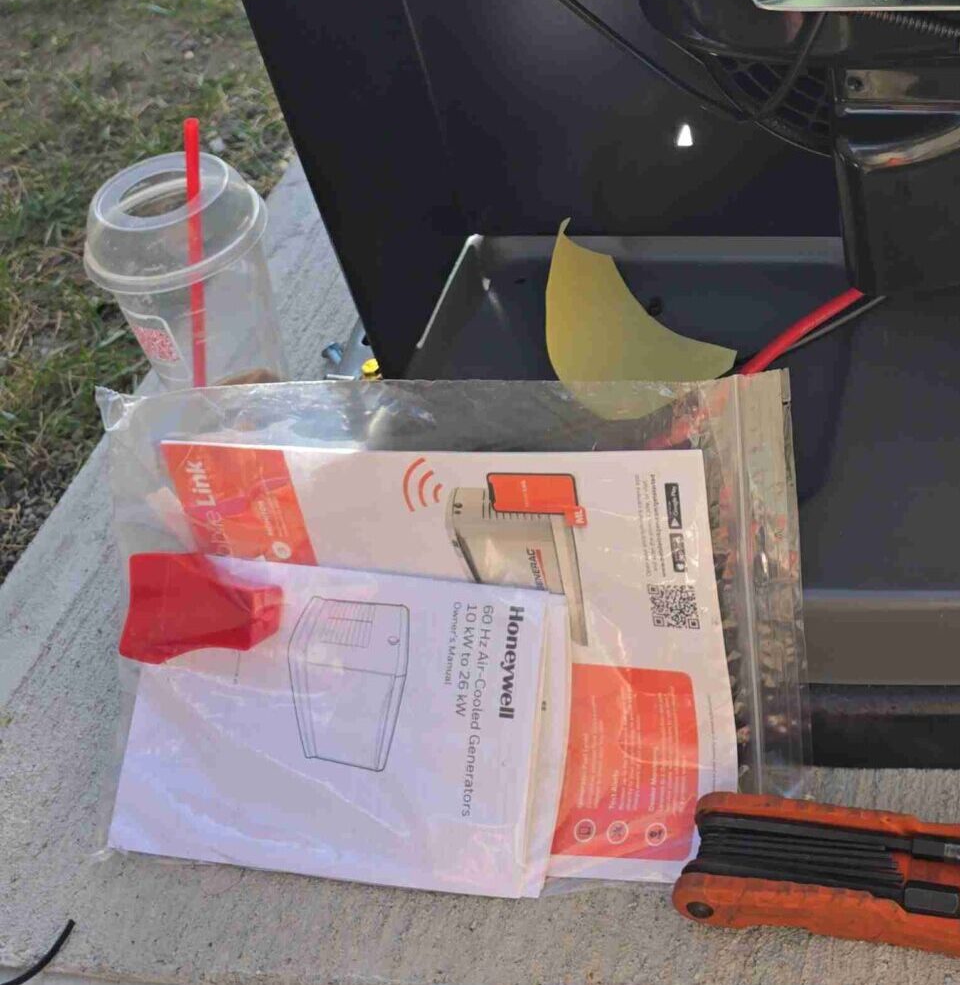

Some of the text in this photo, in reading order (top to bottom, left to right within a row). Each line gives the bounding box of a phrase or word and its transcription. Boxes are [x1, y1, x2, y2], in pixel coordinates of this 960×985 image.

[184, 460, 216, 507] Link
[444, 601, 462, 685] Owner's Manual
[455, 605, 478, 717] 10 kW to 26 kW
[499, 606, 525, 720] Honeywell
[461, 604, 494, 817] 60 Hz Air-Cooled Generators
